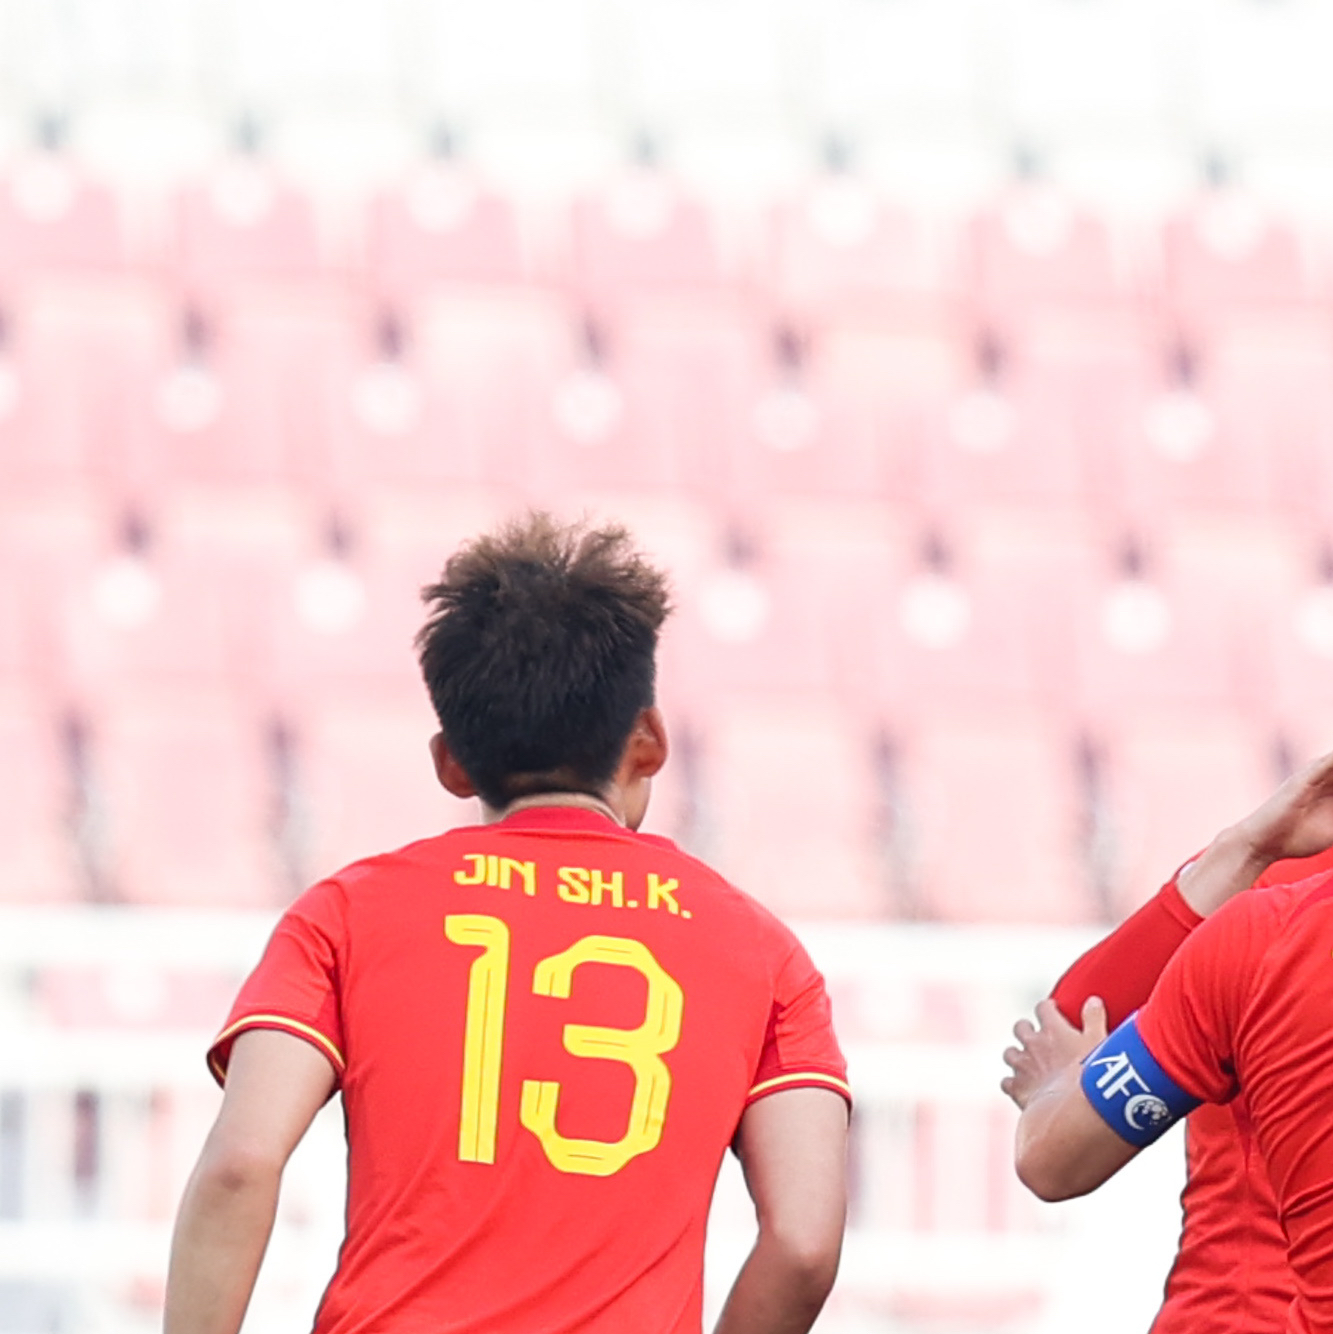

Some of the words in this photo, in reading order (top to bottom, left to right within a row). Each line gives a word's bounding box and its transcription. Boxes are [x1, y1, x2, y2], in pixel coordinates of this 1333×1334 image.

[454, 854, 536, 896] JIN
[557, 867, 692, 919] SH.K.
[445, 914, 684, 1176] 13
[1090, 1051, 1170, 1130] AFC
